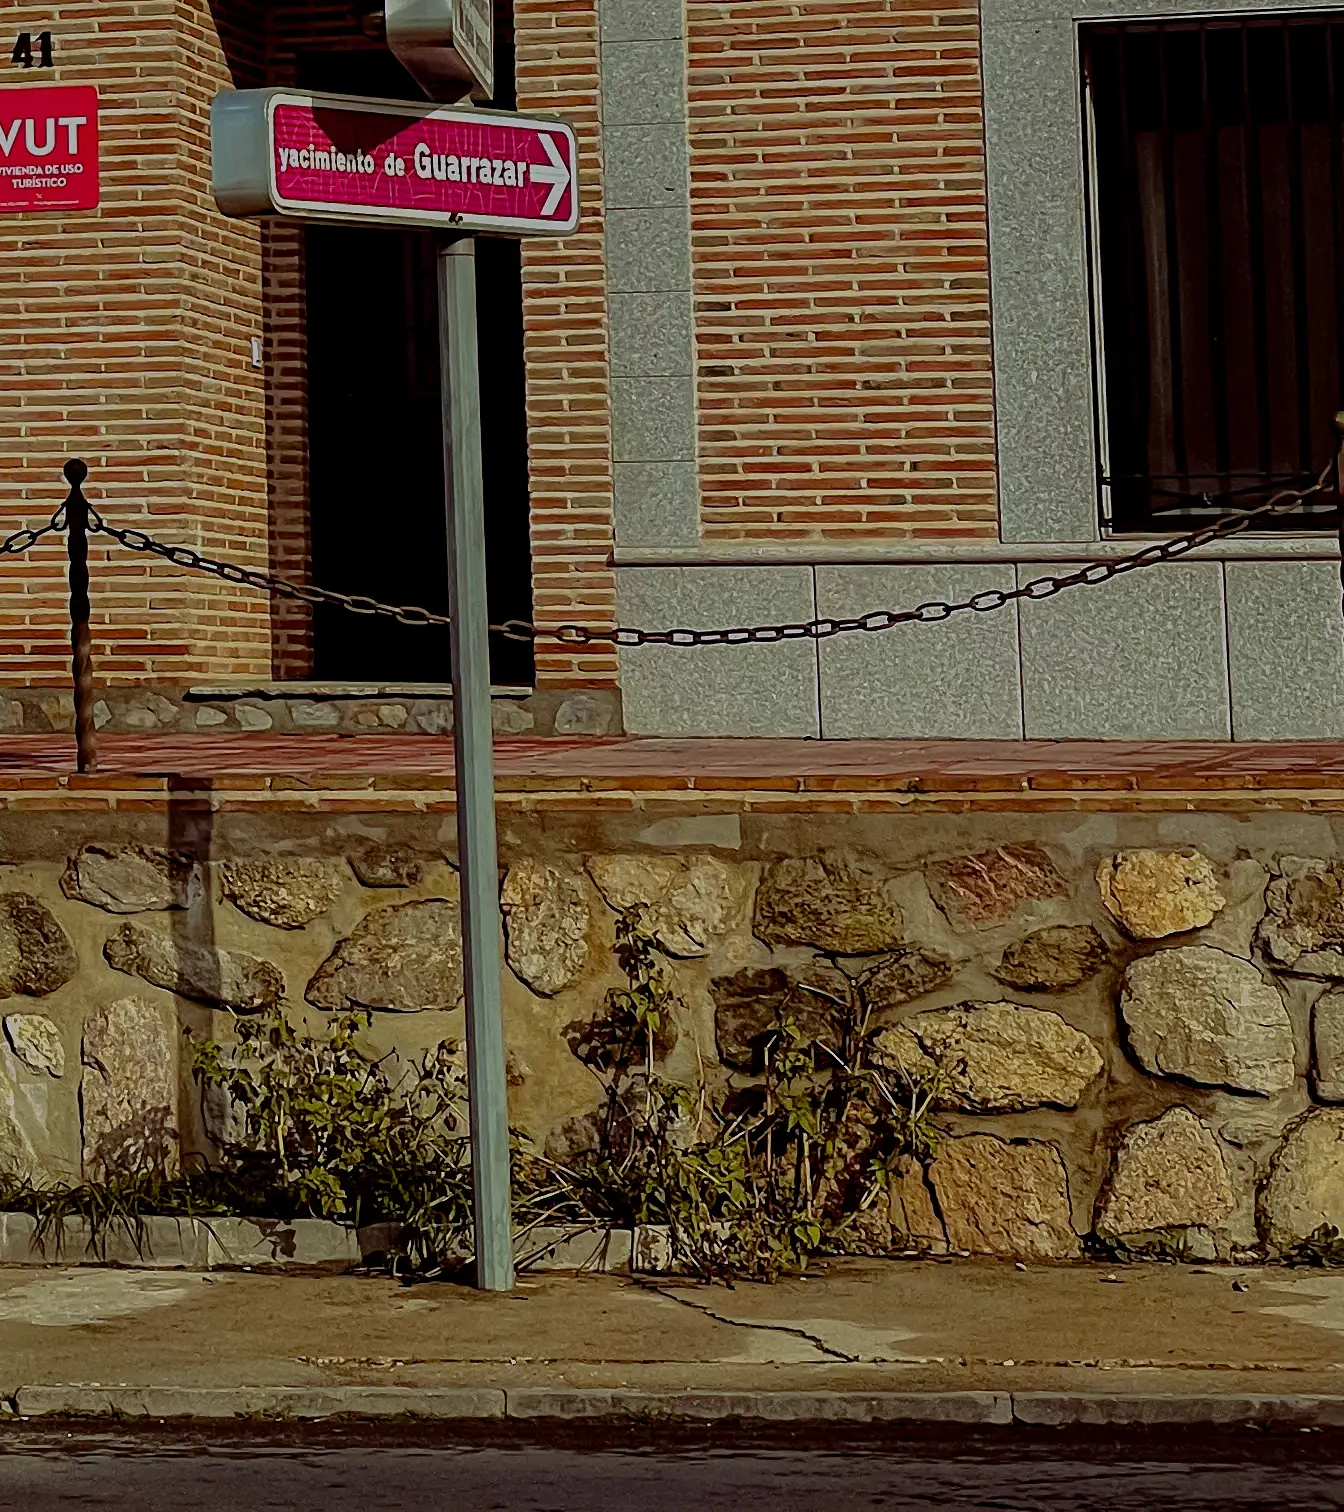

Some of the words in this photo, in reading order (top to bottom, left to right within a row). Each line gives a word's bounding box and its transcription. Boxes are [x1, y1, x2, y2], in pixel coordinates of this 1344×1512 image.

[11, 31, 54, 69] 41
[44, 164, 60, 175] DE
[60, 163, 83, 174] USO
[278, 144, 375, 173] yacimiento
[384, 153, 405, 177] de
[414, 142, 527, 188] Guarrazar
[12, 176, 67, 189] TURÍSTICO
